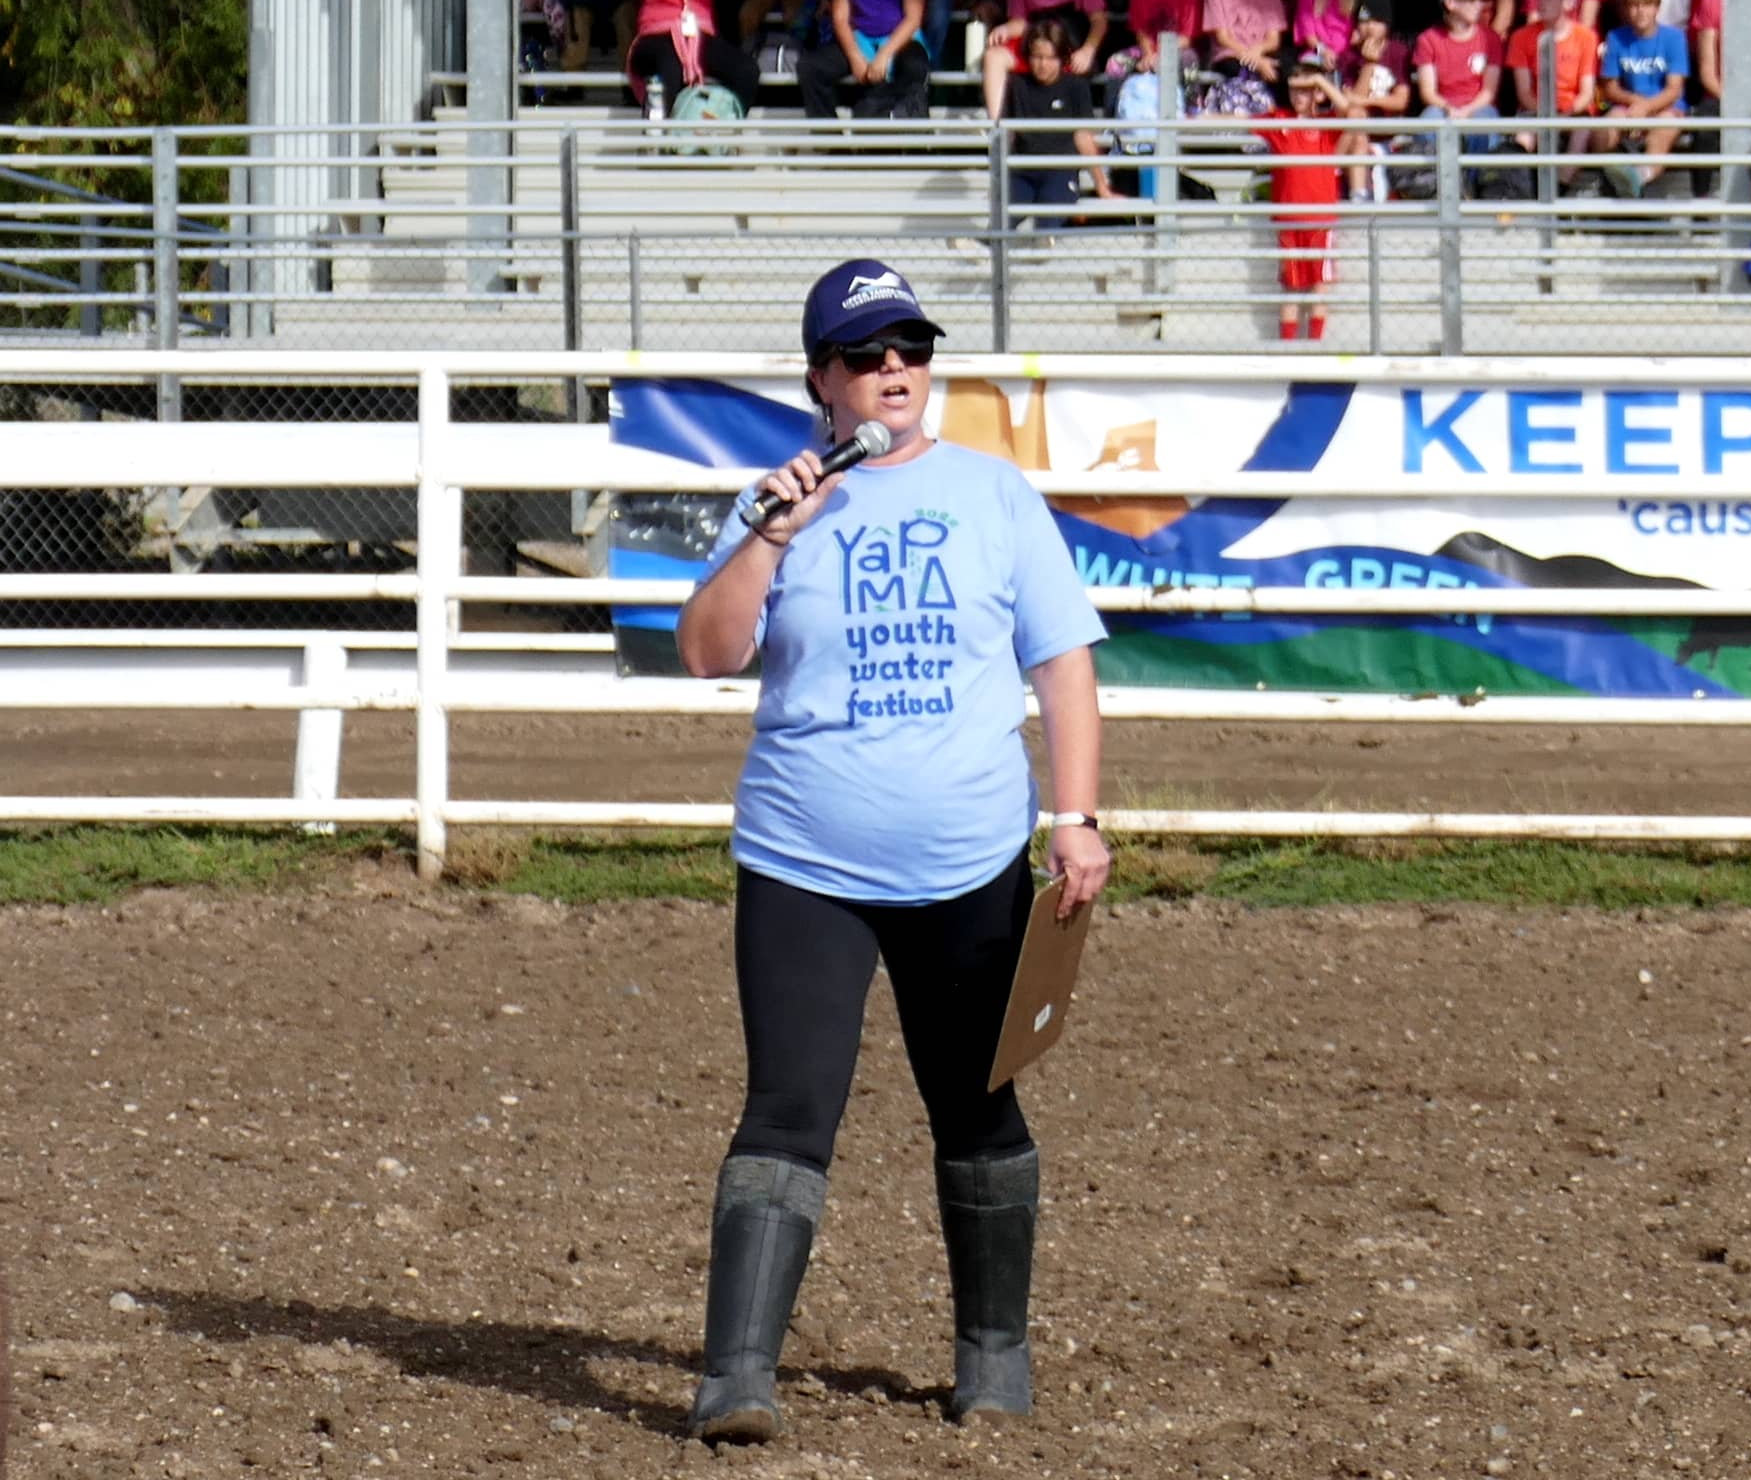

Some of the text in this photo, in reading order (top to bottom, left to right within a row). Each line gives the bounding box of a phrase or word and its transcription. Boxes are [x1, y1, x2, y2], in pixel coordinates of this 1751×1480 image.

[845, 614, 957, 660] youth
[849, 651, 953, 683] water
[846, 685, 955, 728] festival
